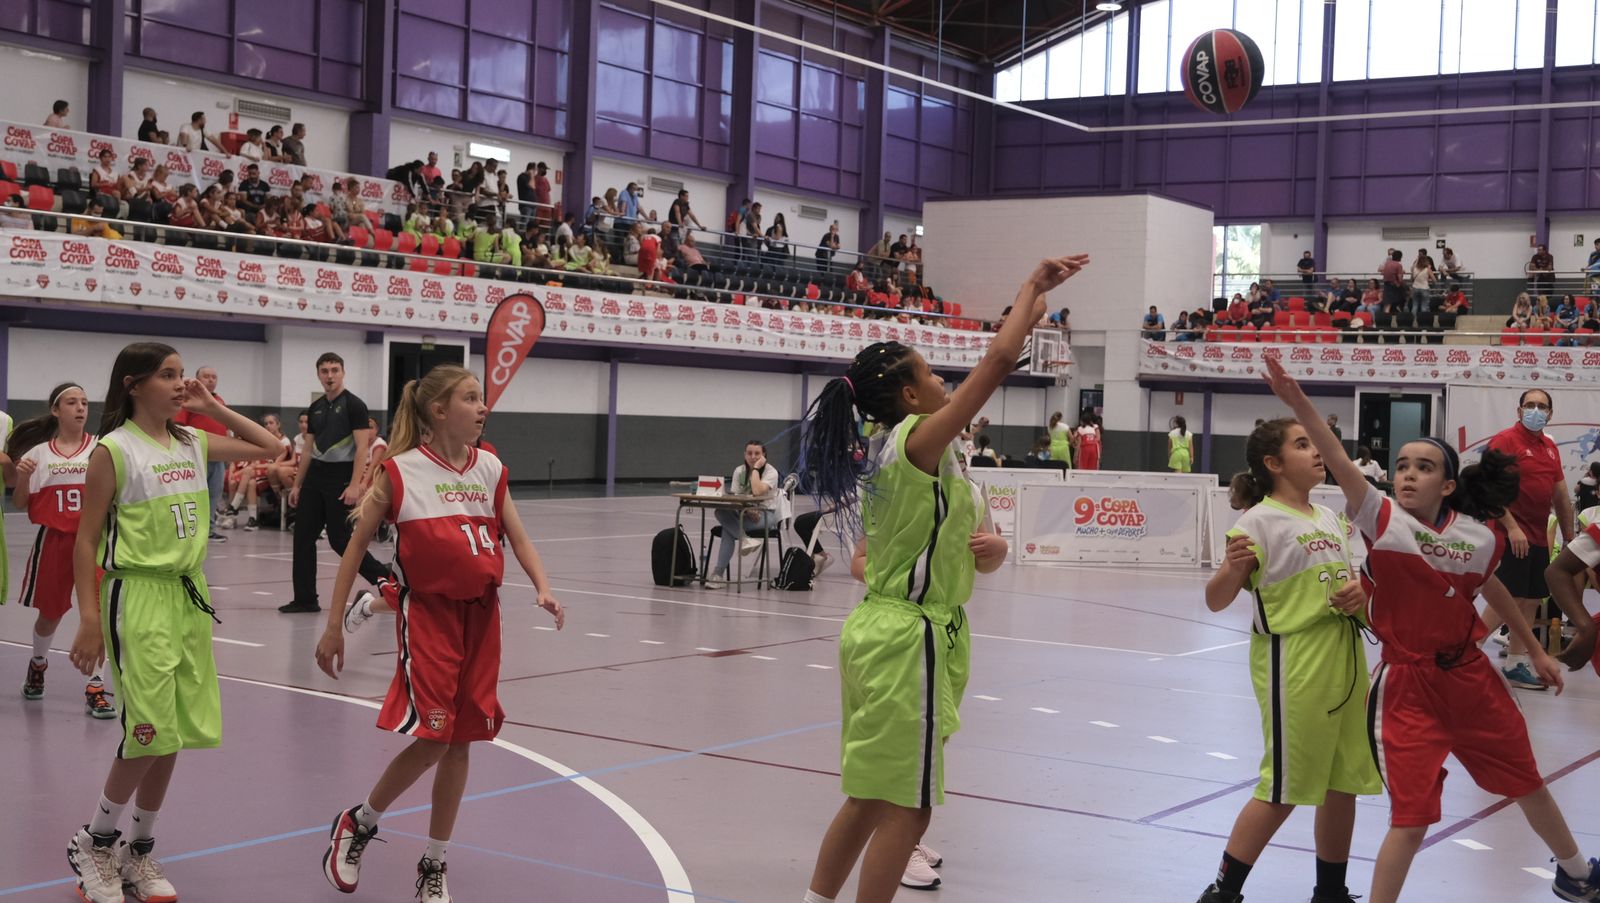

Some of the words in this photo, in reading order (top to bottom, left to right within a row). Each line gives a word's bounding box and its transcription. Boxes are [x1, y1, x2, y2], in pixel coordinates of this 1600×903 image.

[1196, 50, 1216, 104] COVAP
[12, 236, 42, 250] COPA
[62, 240, 90, 254] COPA
[10, 247, 47, 261] COVAP
[108, 244, 135, 258] COPA
[154, 250, 180, 264] COPA
[60, 252, 95, 265] COVAP
[105, 256, 140, 270] COVAP
[197, 256, 221, 269] COPA
[151, 261, 184, 275] COVAP
[195, 266, 226, 279] COVAP
[240, 260, 262, 272] COPA
[278, 264, 302, 277] COPA
[237, 271, 267, 283] COVAP
[276, 275, 306, 287] COVAP
[317, 268, 339, 281] COPA
[353, 272, 375, 284] COPA
[315, 279, 342, 291] COVAP
[351, 281, 378, 293] COVAP
[491, 301, 531, 385] COVAP
[1513, 357, 1539, 365] COVAP
[1515, 350, 1536, 359] COPA
[1550, 351, 1570, 359] COPA
[1547, 357, 1573, 366] COVAP
[52, 467, 86, 475] COVAP
[55, 489, 82, 513] 19
[445, 492, 488, 503] COVAP
[1101, 498, 1139, 513] COPA
[169, 501, 197, 540] 15
[1096, 512, 1145, 528] COVAP
[460, 523, 496, 556] 14
[1420, 543, 1473, 563] COVAP
